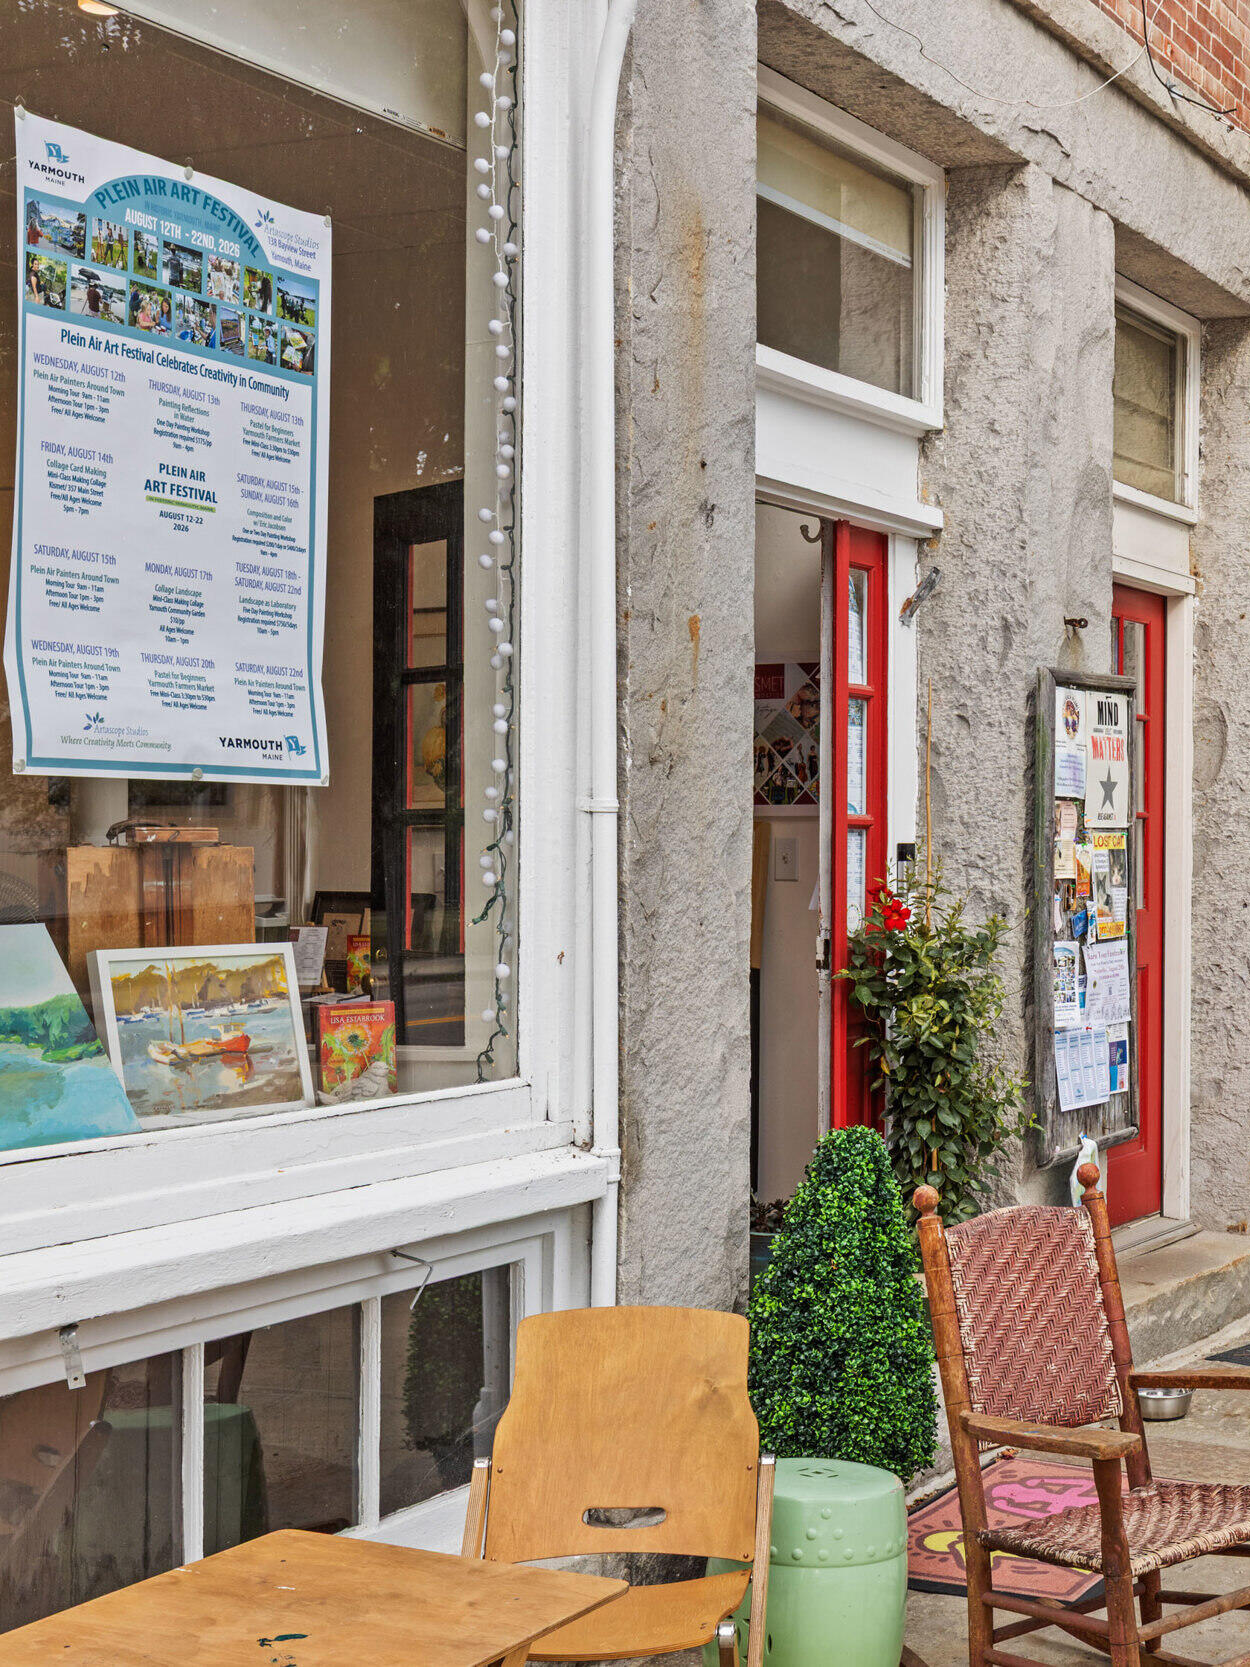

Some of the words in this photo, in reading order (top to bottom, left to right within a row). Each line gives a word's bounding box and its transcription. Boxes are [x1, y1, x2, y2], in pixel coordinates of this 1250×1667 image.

[28, 160, 85, 184] YARMOUTH
[45, 176, 65, 186] MAINE
[94, 178, 141, 210] PLEIN
[144, 178, 167, 197] AIR
[170, 182, 200, 206] ART
[202, 194, 260, 259] FESTIVAL
[125, 208, 158, 231] AUGUST
[160, 220, 182, 239] 12TH
[191, 230, 217, 252] 22ND,
[219, 239, 240, 258] 2026
[295, 234, 320, 249] Studios
[268, 236, 277, 246] 138
[278, 239, 298, 253] Bayview
[299, 246, 316, 259] Street
[294, 259, 312, 271] Maine
[33, 352, 79, 373] WEDNESDAY,
[81, 363, 108, 380] AUGUST
[110, 370, 126, 383] 12th
[61, 328, 86, 347] Plein
[88, 335, 103, 351] Air
[104, 339, 119, 356] Art
[121, 343, 155, 364] Festival
[156, 350, 198, 375] Celebrates
[199, 364, 238, 388] Creativity
[239, 374, 247, 388] in
[248, 376, 290, 401] Community
[33, 369, 49, 381] Plein
[49, 372, 58, 382] Air
[59, 375, 86, 388] Painters
[87, 381, 109, 394] Around
[109, 385, 125, 397] Town
[48, 384, 69, 397] Morning
[69, 389, 80, 397] Tour
[82, 391, 93, 400] 9am
[148, 379, 181, 397] THURSDAY,
[182, 388, 206, 402] AUGUST
[207, 394, 221, 406] 13th
[159, 397, 181, 412] Painting
[182, 403, 210, 417] Reflections
[240, 401, 269, 419] THURSDAY,
[270, 409, 291, 423] AUGUST
[291, 415, 304, 426] 13th
[72, 410, 83, 420] Ages
[84, 412, 106, 424] Welcome
[180, 412, 195, 423] Water
[41, 440, 67, 457] FRIDAY,
[68, 446, 96, 460] AUGUST
[98, 452, 113, 464] 14th
[47, 459, 69, 472] Collage
[70, 463, 83, 473] Card
[85, 466, 106, 479] Making
[159, 462, 187, 478] PLEIN
[189, 469, 206, 483] AIR
[68, 484, 77, 492] 357
[77, 486, 89, 494] Main
[90, 488, 104, 497] Street
[72, 475, 90, 486] Making
[90, 478, 106, 489] Collage
[236, 473, 265, 488] SATURDAY,
[266, 479, 288, 491] AUGUST
[288, 484, 300, 494] 15th
[144, 479, 167, 494] ART
[170, 483, 218, 504] FESTIVAL
[241, 489, 263, 503] SUNDAY,
[265, 494, 286, 506] AUGUST
[63, 505, 74, 513] 5pm
[78, 507, 89, 515] 7pm
[159, 510, 184, 522] AUGUST
[186, 514, 204, 524] 12-22
[173, 523, 190, 532] 2026
[34, 544, 70, 560] SATURDAY,
[71, 550, 99, 563] AUGUST
[101, 554, 116, 565] 15th
[30, 565, 45, 574] Plein
[47, 567, 55, 576] Air
[56, 568, 80, 579] Painters
[81, 572, 103, 582] Around
[104, 575, 120, 584] Town
[145, 562, 173, 576] MONDAY,
[174, 566, 198, 579] AUGUST
[199, 570, 213, 581] 17th
[236, 562, 261, 575] TUESDAY,
[262, 566, 283, 579] AUGUST
[155, 584, 174, 595] Collage
[175, 586, 202, 598] Landscape
[235, 577, 264, 591] SATURDAY,
[265, 581, 286, 593] AUGUST
[287, 585, 302, 595] 22nd
[31, 640, 75, 655] WEDNESDAY,
[76, 644, 103, 656] AUGUST
[104, 647, 120, 658] 19th
[32, 657, 47, 666] Plein
[48, 658, 57, 667] Air
[58, 660, 82, 669] Painters
[83, 662, 104, 671] Around
[105, 663, 121, 672] Town
[141, 652, 174, 667] THURSDAY,
[176, 656, 200, 668] AUGUST
[201, 658, 215, 669] 20th
[235, 662, 265, 675] SATURDAY,
[266, 665, 288, 677] AUGUST
[289, 668, 303, 678] 22nd
[1097, 700, 1119, 726] MIND
[93, 725, 125, 737] Artascope
[126, 726, 149, 737] Studios
[60, 735, 82, 745] Where
[83, 737, 115, 749] Creativity
[116, 739, 134, 748] Meets
[135, 740, 172, 752] Community
[219, 737, 283, 751] YARMOUTH
[1091, 735, 1125, 762] MATTERS
[262, 753, 283, 761] MAINE
[1093, 834, 1111, 848] LOST
[1112, 834, 1124, 848] CAT
[330, 1016, 345, 1025] LISA
[346, 1014, 385, 1023] ESTABROOK
